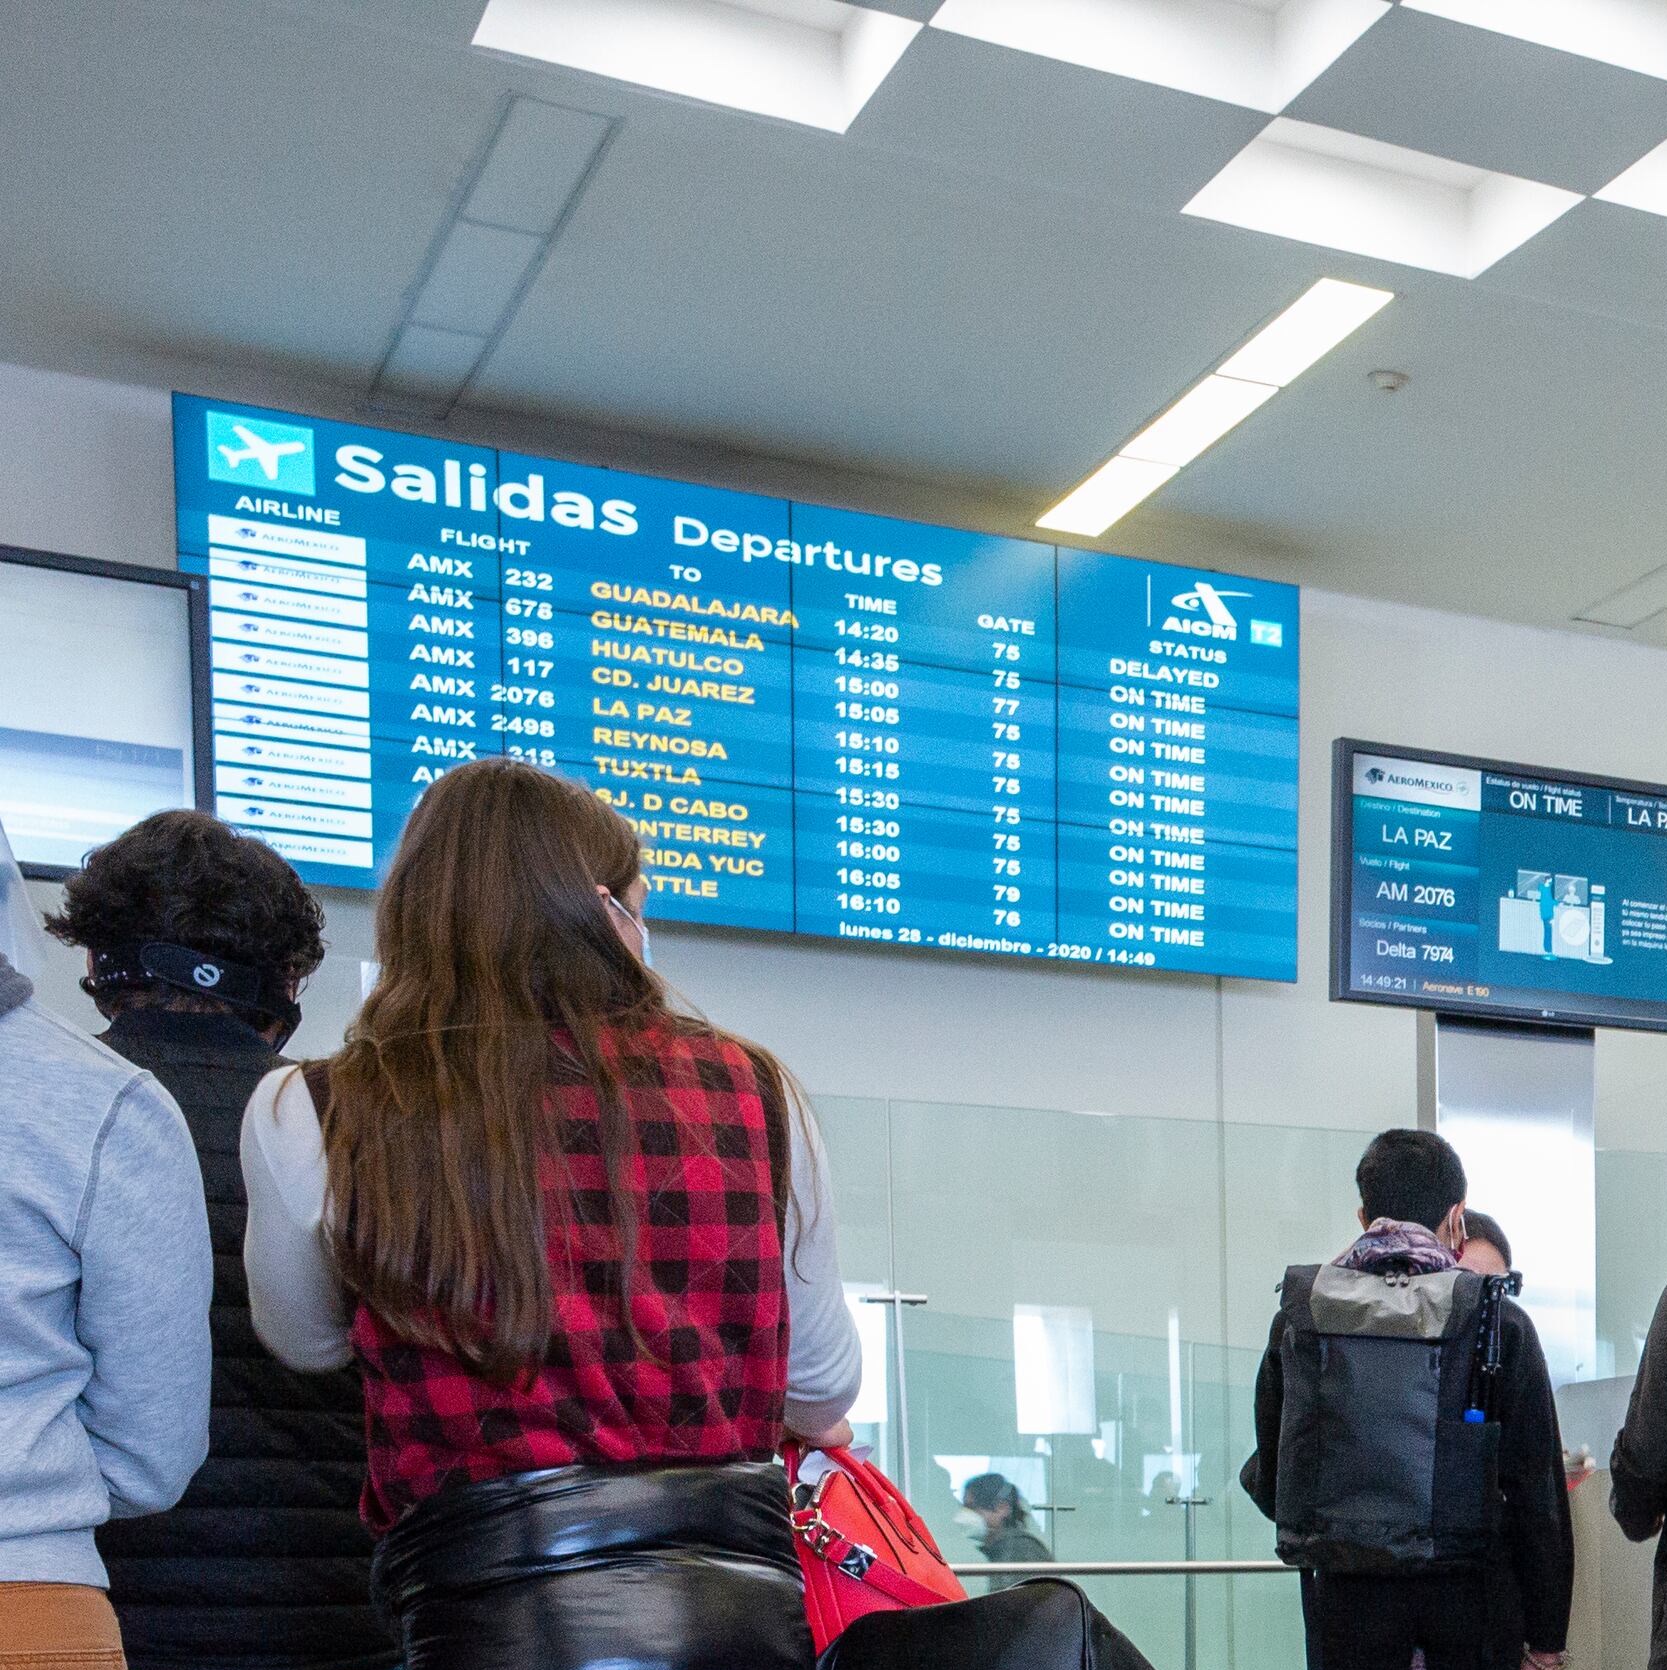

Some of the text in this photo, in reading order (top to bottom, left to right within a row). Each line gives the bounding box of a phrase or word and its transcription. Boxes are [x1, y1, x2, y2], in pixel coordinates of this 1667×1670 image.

[235, 496, 341, 526] AIRLINE
[334, 445, 943, 587] Salidas Departures
[441, 528, 531, 556] FLIGHT
[408, 553, 553, 591] AMX 232
[669, 564, 702, 582] TO
[408, 583, 553, 620] AMX 678
[591, 582, 800, 629] GUADALAJARA
[844, 593, 898, 615] TIME
[409, 614, 554, 649] AMX 396
[591, 611, 765, 651] GUATEMALA
[834, 619, 899, 643] 14:20
[977, 614, 1035, 635] GATE
[1162, 616, 1237, 640] AICM
[1252, 621, 1281, 643] T2
[409, 644, 554, 678] AMX 117
[591, 639, 744, 675] HUATULCO
[835, 647, 899, 672] 14:35
[992, 642, 1021, 661] 75
[1149, 640, 1228, 664] STATUS
[592, 667, 755, 704] CD. JUAREZ
[992, 670, 1021, 689] 75
[1110, 658, 1220, 688] DELAYED
[410, 674, 555, 708] AMX 2076
[835, 676, 899, 698] 15:00
[593, 698, 692, 727] LA PAZ
[835, 701, 899, 724] 15:05
[992, 698, 1021, 716] 77
[1109, 685, 1206, 715] ON TIME
[411, 704, 555, 738] AMX 2498
[992, 722, 1021, 741] 75
[1109, 712, 1206, 740] ON TIME
[412, 735, 477, 760] AMX
[593, 727, 728, 760] REYNOSA
[835, 731, 899, 753] 15:10
[1109, 737, 1206, 764] ON TIME
[593, 756, 701, 785] TUXTLA
[835, 756, 900, 779] 15:15
[992, 751, 1021, 770] 75
[992, 776, 1021, 795] 75
[1109, 765, 1206, 792] ON TIME
[1387, 774, 1453, 792] AEROMEXICO
[594, 788, 749, 821] SJ. D CABO
[835, 786, 899, 810] 15:30
[1109, 790, 1206, 816] ON TIME
[1509, 791, 1582, 817] ON TIME
[836, 815, 900, 838] 15:30
[992, 806, 1021, 825] 75
[1628, 807, 1651, 827] LA
[627, 816, 766, 849] ONTERREY
[992, 833, 1021, 852] 75
[1109, 818, 1206, 845] ON TIME
[1382, 824, 1452, 850] LA PAZ
[640, 848, 765, 876] RIDA YUC
[836, 840, 900, 862] 16:00
[1109, 845, 1206, 871] ON TIME
[836, 867, 901, 889] 16:05
[992, 858, 1021, 876] 75
[992, 884, 1021, 902] 79
[1109, 869, 1206, 895] ON TIME
[1376, 881, 1455, 907] AM 2076
[836, 892, 901, 914] 16:10
[1109, 896, 1206, 921] ON TIME
[992, 909, 1021, 927] 76
[839, 921, 1156, 966] lunes 28 diciembre 2020 14:49
[1109, 922, 1206, 947] ON TIME
[1376, 940, 1454, 963] Delta 7974
[1360, 974, 1406, 989] 14:49:21
